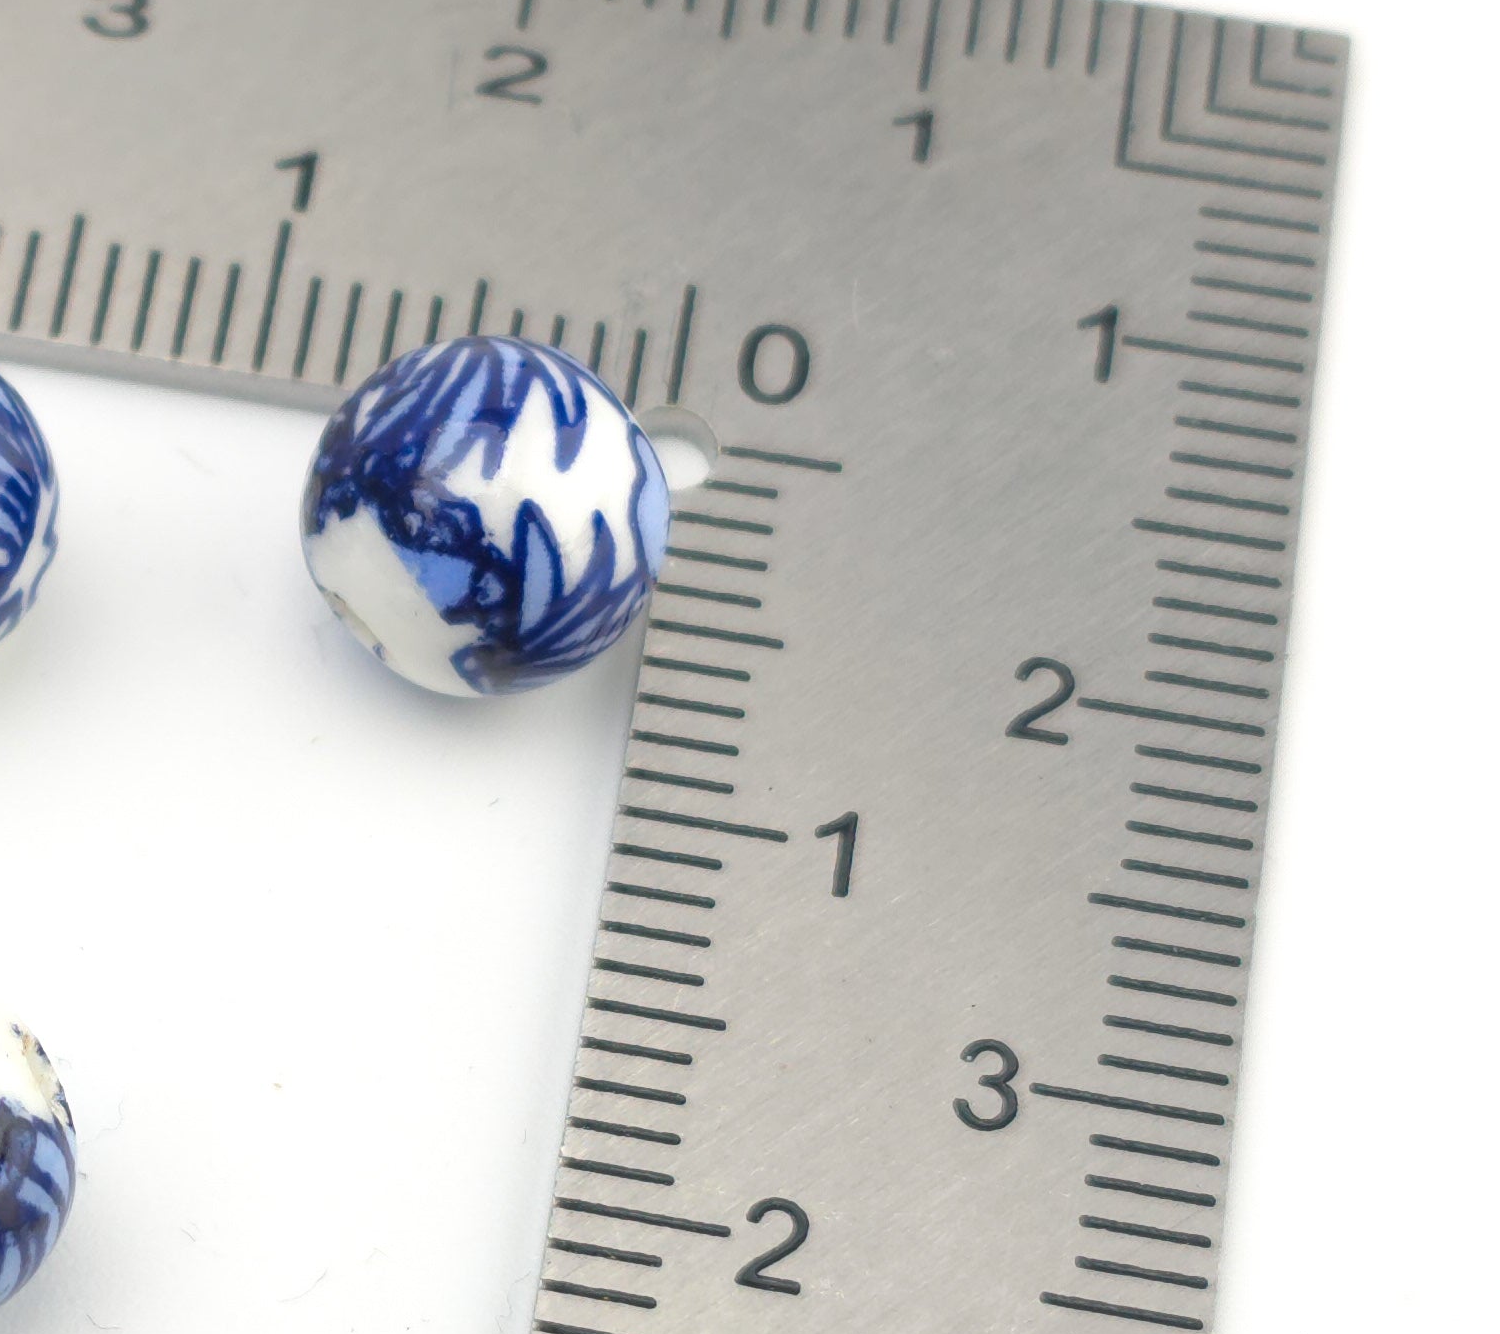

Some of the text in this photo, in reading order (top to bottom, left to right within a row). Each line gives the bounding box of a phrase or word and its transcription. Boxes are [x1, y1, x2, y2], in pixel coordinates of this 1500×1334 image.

[477, 45, 549, 105] 2
[894, 108, 936, 164] 1
[277, 151, 318, 212] 1
[738, 323, 810, 405] 0
[1078, 305, 1120, 383] 1
[1005, 657, 1076, 745] 2
[815, 812, 858, 897] 1
[953, 1039, 1019, 1131] 3
[735, 1197, 809, 1296] 2
